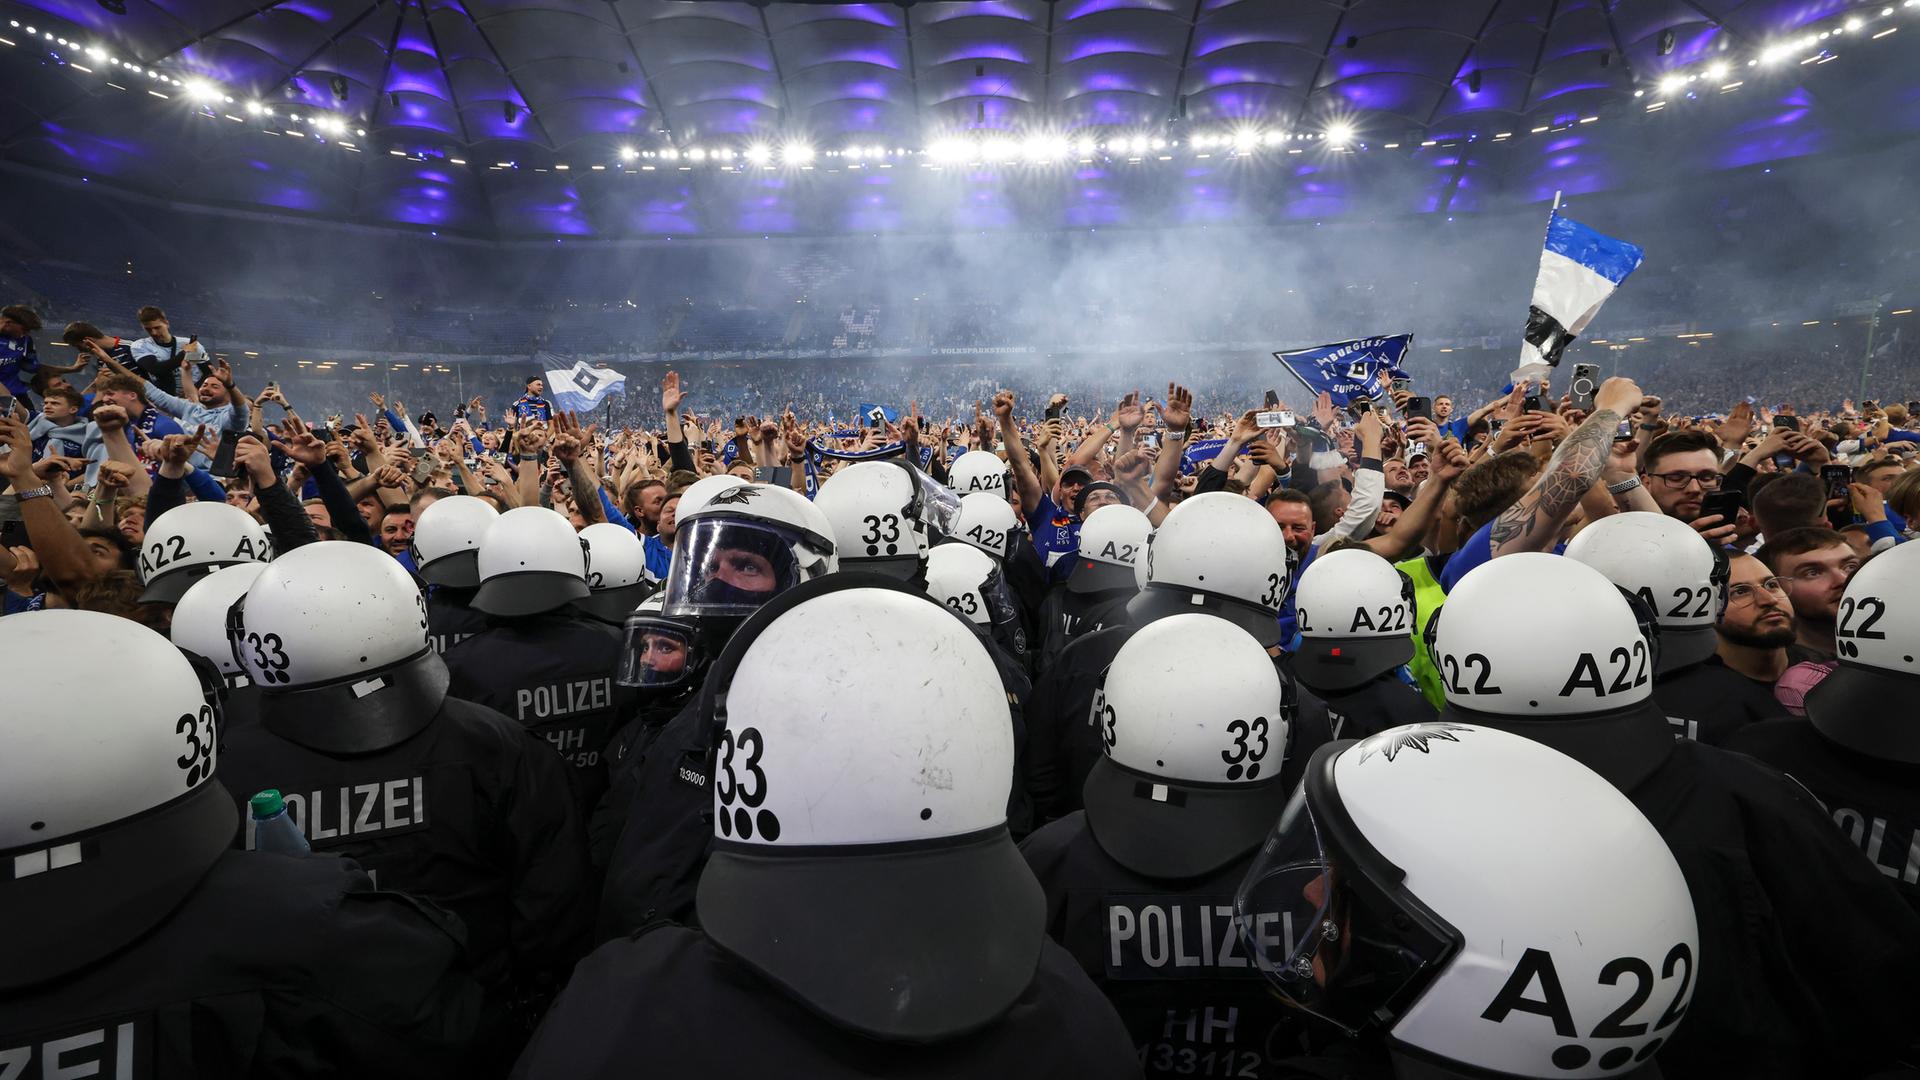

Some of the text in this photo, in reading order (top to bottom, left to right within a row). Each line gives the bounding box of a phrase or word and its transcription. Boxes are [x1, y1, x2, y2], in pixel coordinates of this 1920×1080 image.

[969, 473, 1002, 491] A22
[862, 513, 900, 545] 33
[966, 524, 1005, 549] A22
[141, 535, 192, 579] A22
[1261, 573, 1286, 608] 33
[1349, 604, 1406, 633] A22
[1836, 596, 1886, 640] 22
[247, 632, 290, 670] 33
[1558, 640, 1648, 698] A22
[517, 677, 612, 721] POLIZEI
[176, 704, 214, 770] 33
[1221, 716, 1269, 765] 33
[717, 727, 767, 808] 33
[1109, 905, 1296, 972] POLIZEI
[1480, 942, 1693, 1039] A22
[1163, 1006, 1239, 1044] HH
